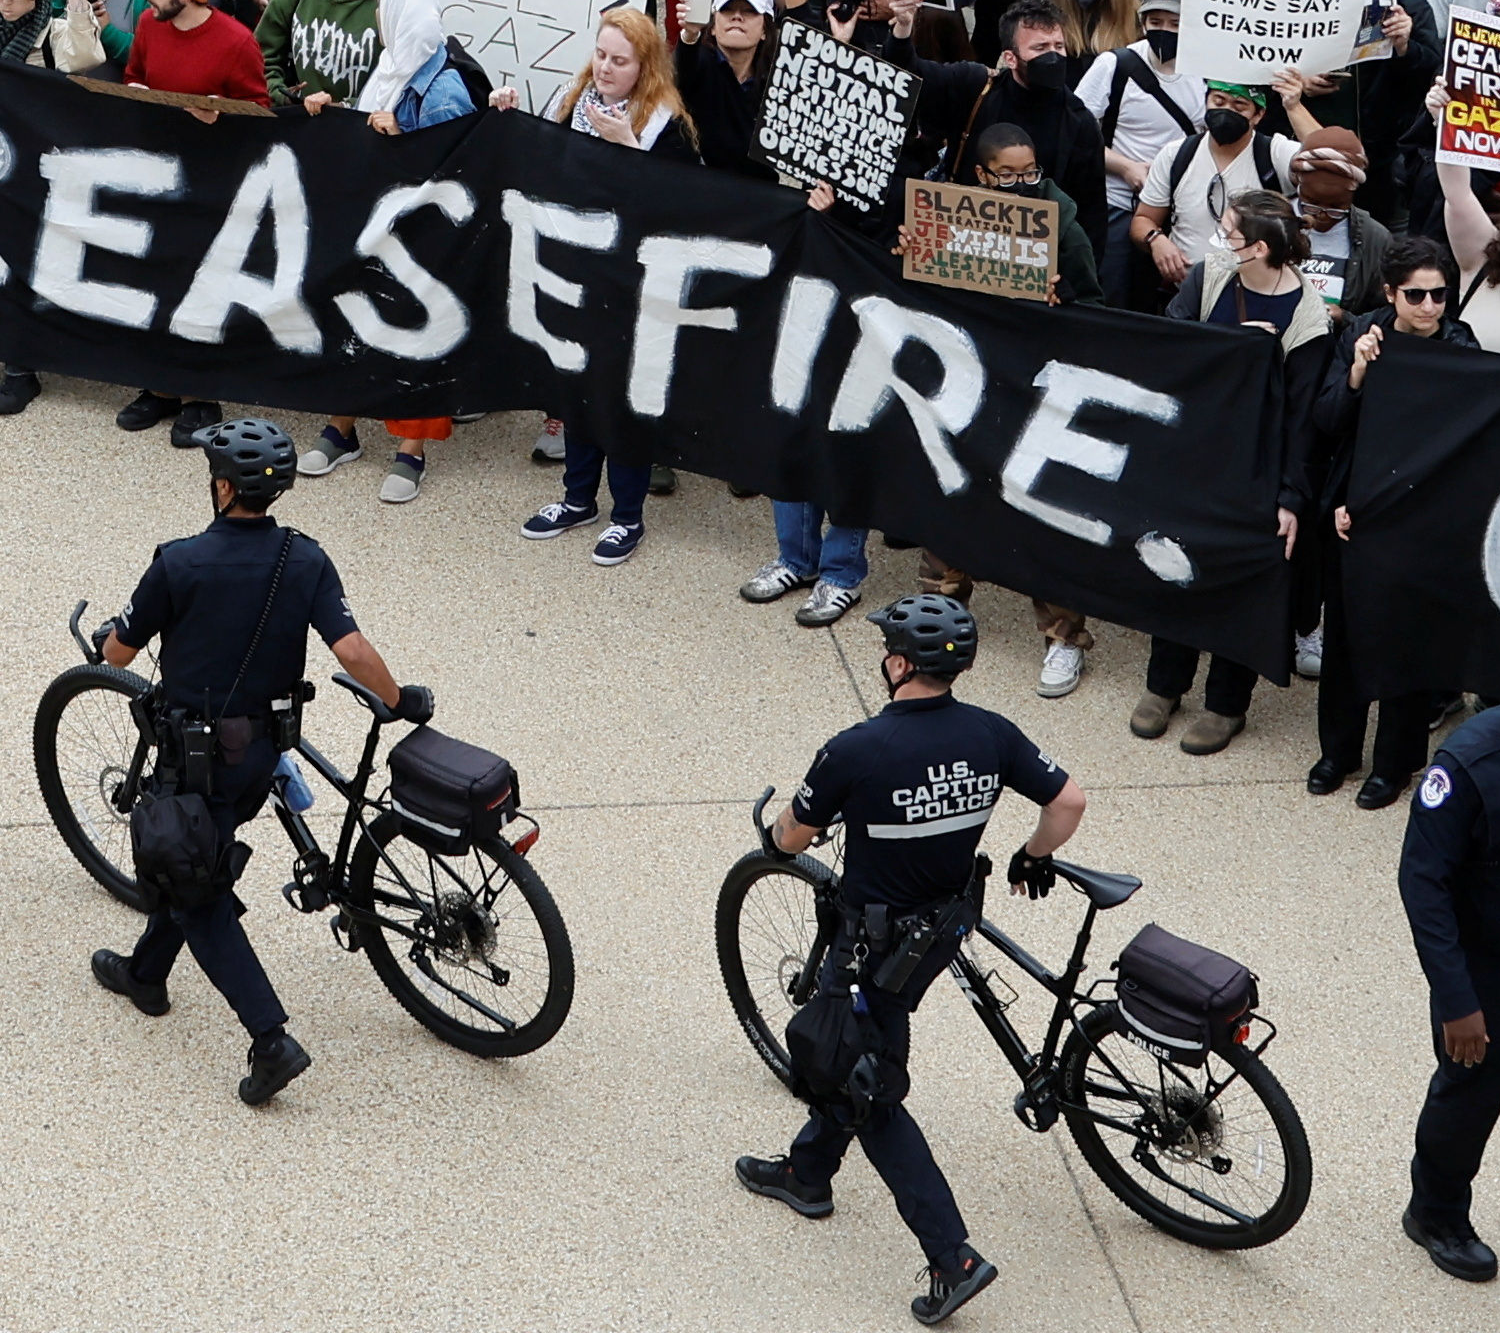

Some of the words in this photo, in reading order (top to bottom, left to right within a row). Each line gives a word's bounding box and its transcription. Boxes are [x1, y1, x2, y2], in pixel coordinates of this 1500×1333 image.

[927, 760, 975, 783] U.S.
[892, 773, 1000, 807] CAPITOL
[906, 791, 995, 823] POLICE
[1125, 1030, 1172, 1061] POLICE
